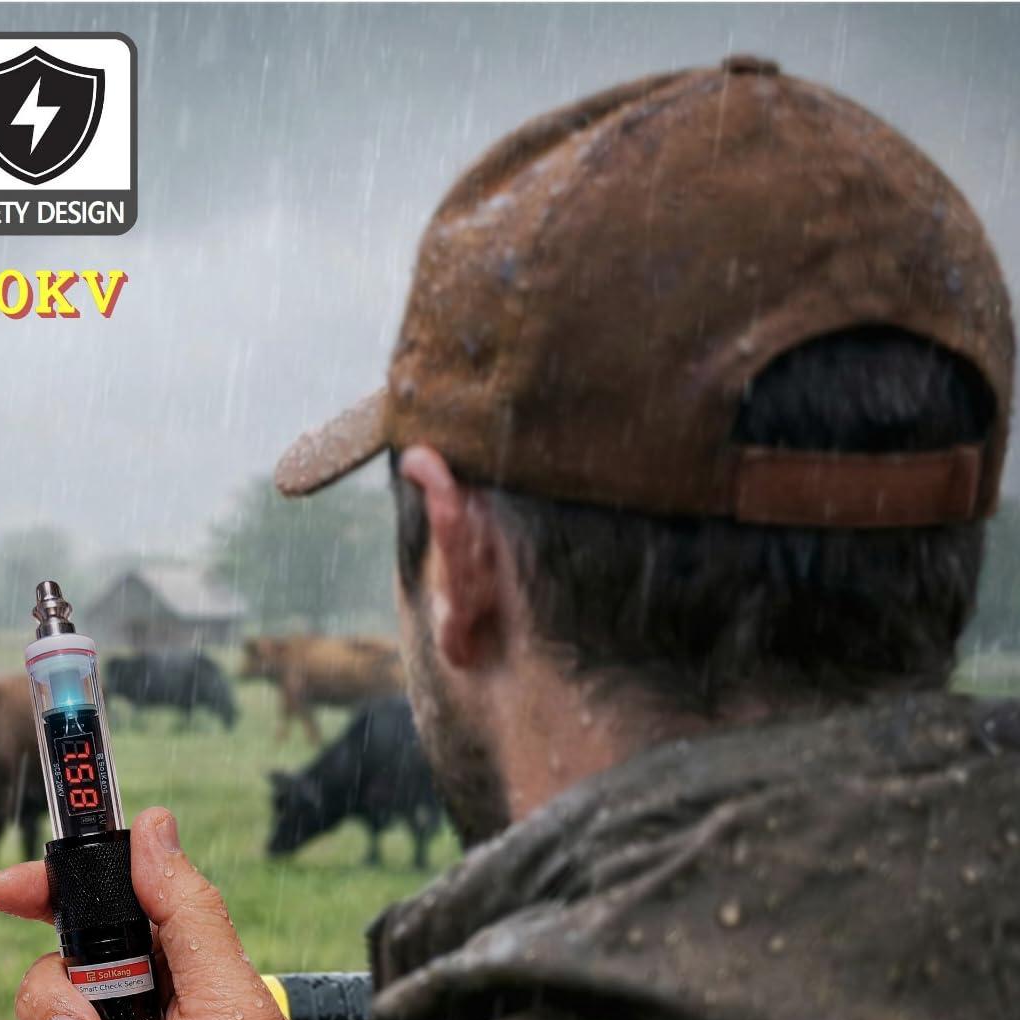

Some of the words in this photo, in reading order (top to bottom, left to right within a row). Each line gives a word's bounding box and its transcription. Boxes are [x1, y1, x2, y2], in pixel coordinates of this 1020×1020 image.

[98, 968, 132, 980] SolKang
[80, 985, 98, 993] Smart
[99, 982, 123, 991] Check
[124, 978, 144, 988] Series
